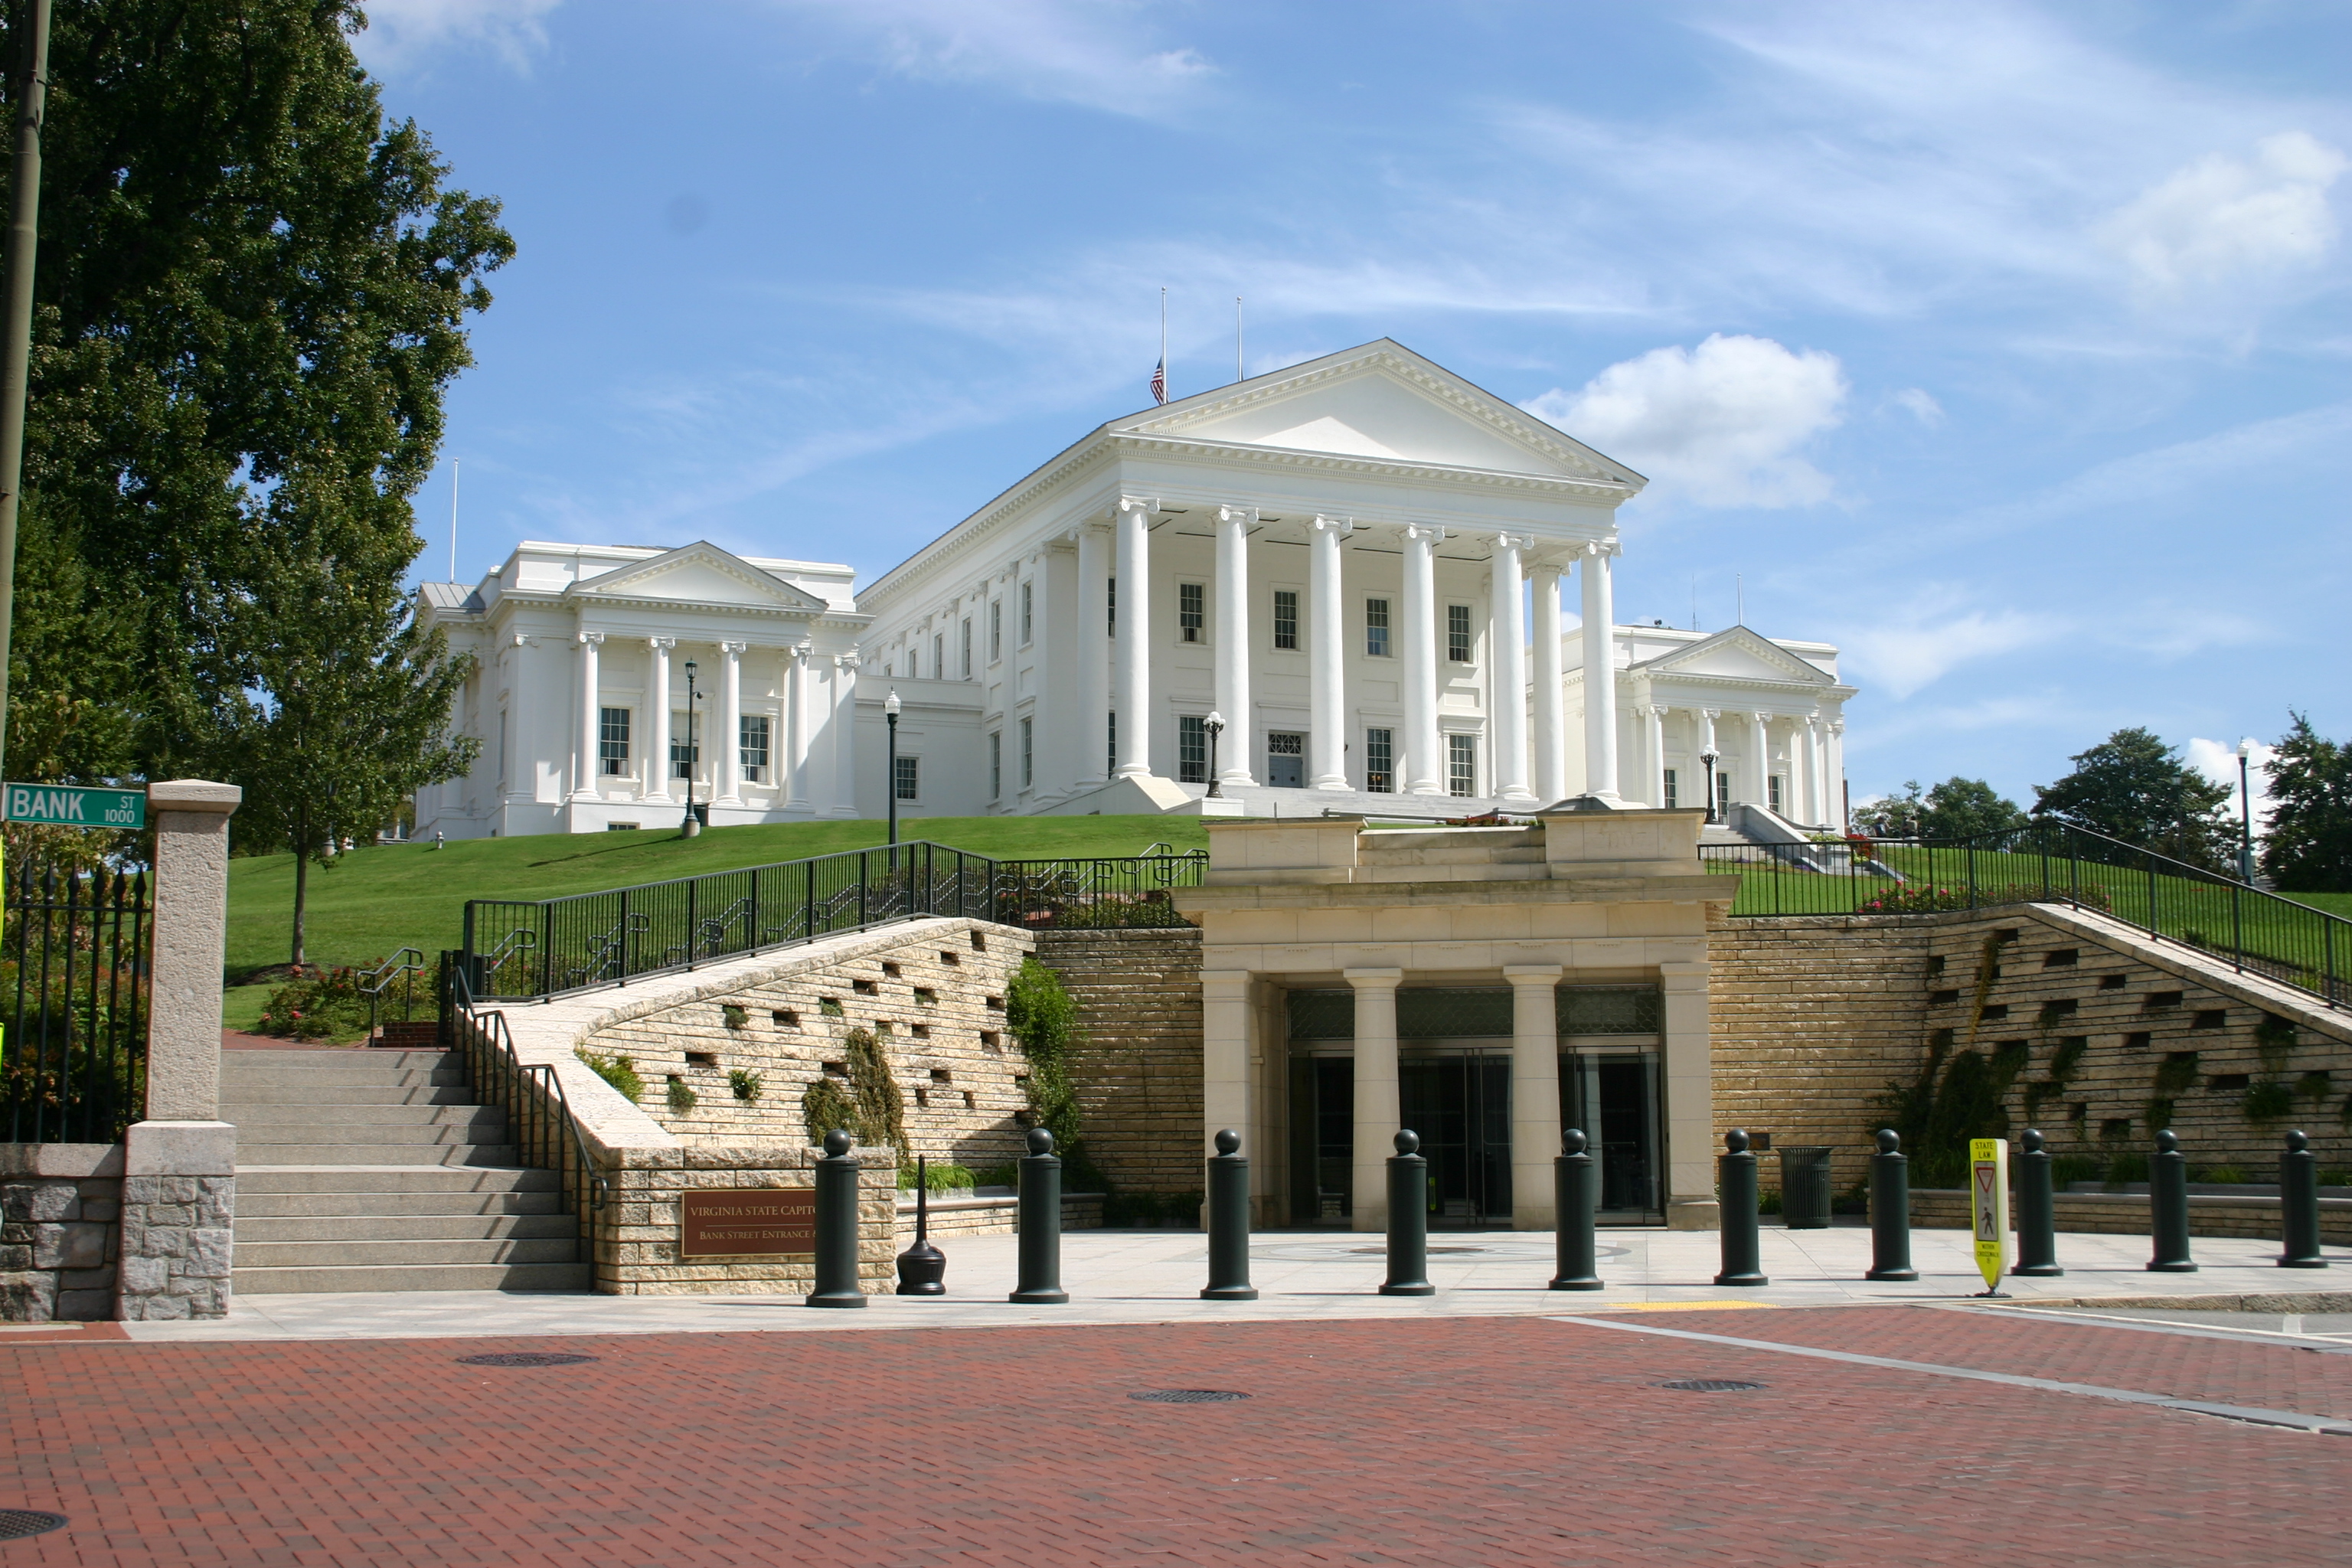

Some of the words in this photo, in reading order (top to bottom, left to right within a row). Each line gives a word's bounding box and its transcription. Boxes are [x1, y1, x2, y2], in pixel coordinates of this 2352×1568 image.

[12, 789, 85, 820] BANK
[120, 795, 136, 809] ST
[104, 808, 136, 823] 1000
[1975, 1142, 1993, 1150] STATE
[1978, 1151, 1991, 1159] LAW
[691, 1206, 743, 1217] VIRGINIA
[745, 1206, 779, 1216] STATE
[700, 1231, 725, 1240] BANK
[727, 1230, 760, 1240] STREET
[762, 1230, 810, 1239] ENTRANCE
